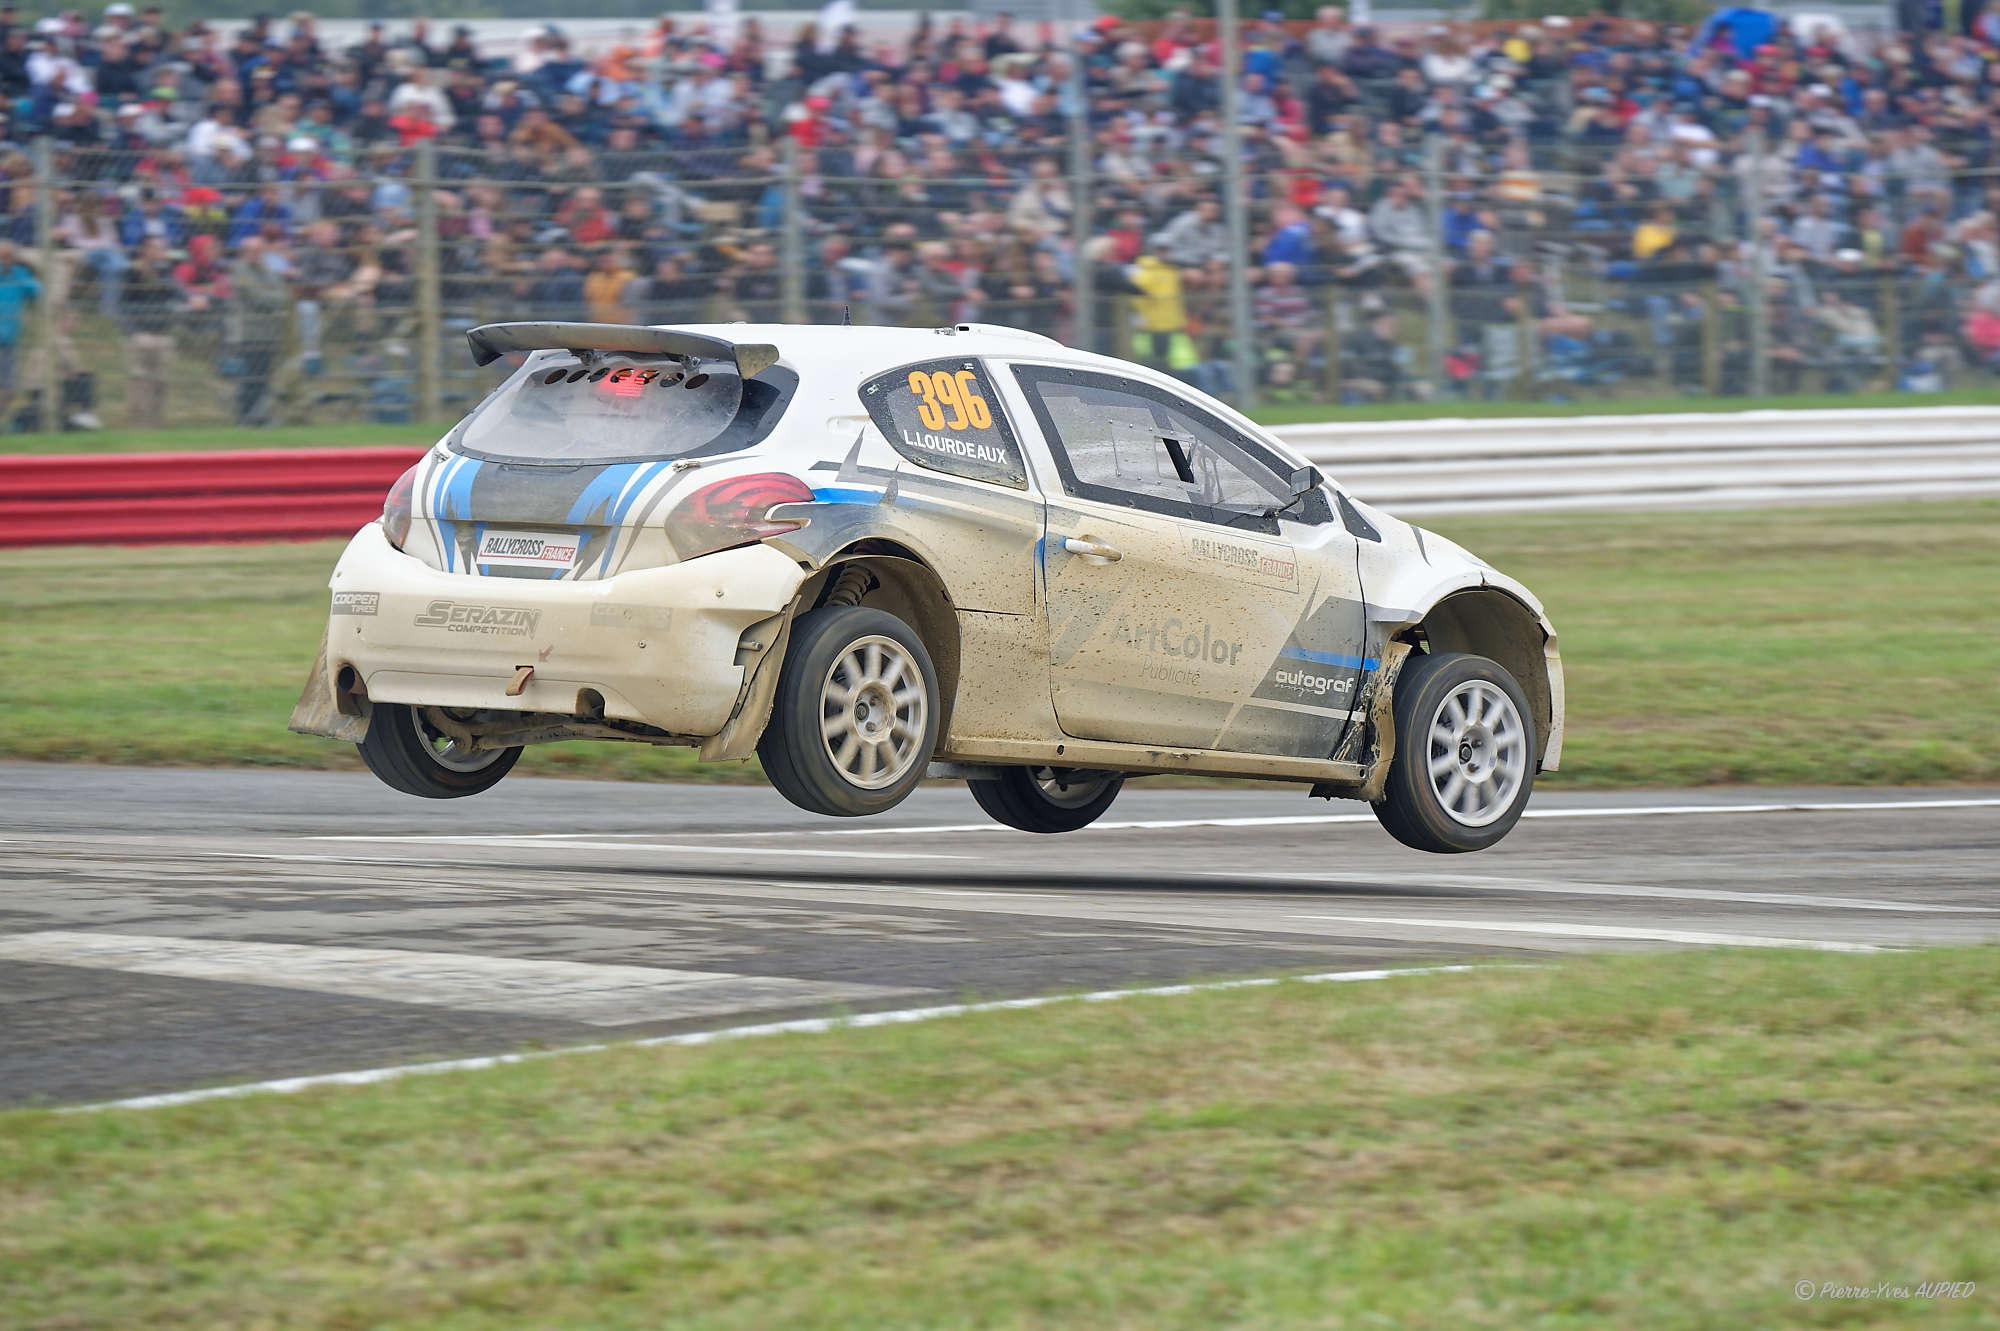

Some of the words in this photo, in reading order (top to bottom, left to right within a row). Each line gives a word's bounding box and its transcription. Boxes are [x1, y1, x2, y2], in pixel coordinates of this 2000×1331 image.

[908, 370, 993, 431] 396
[903, 430, 1007, 465] L.LOURDEAUX
[484, 537, 545, 556] RALLYCROSS
[541, 546, 575, 561] FRANCE
[1192, 538, 1259, 568] RALLYCROSS
[1262, 558, 1294, 579] FRANCE
[333, 594, 378, 605] COOPER
[414, 600, 542, 640] SERAZIN
[448, 624, 528, 637] COMPETITION
[1106, 612, 1243, 666] ArtColor
[1275, 670, 1355, 695] autograf
